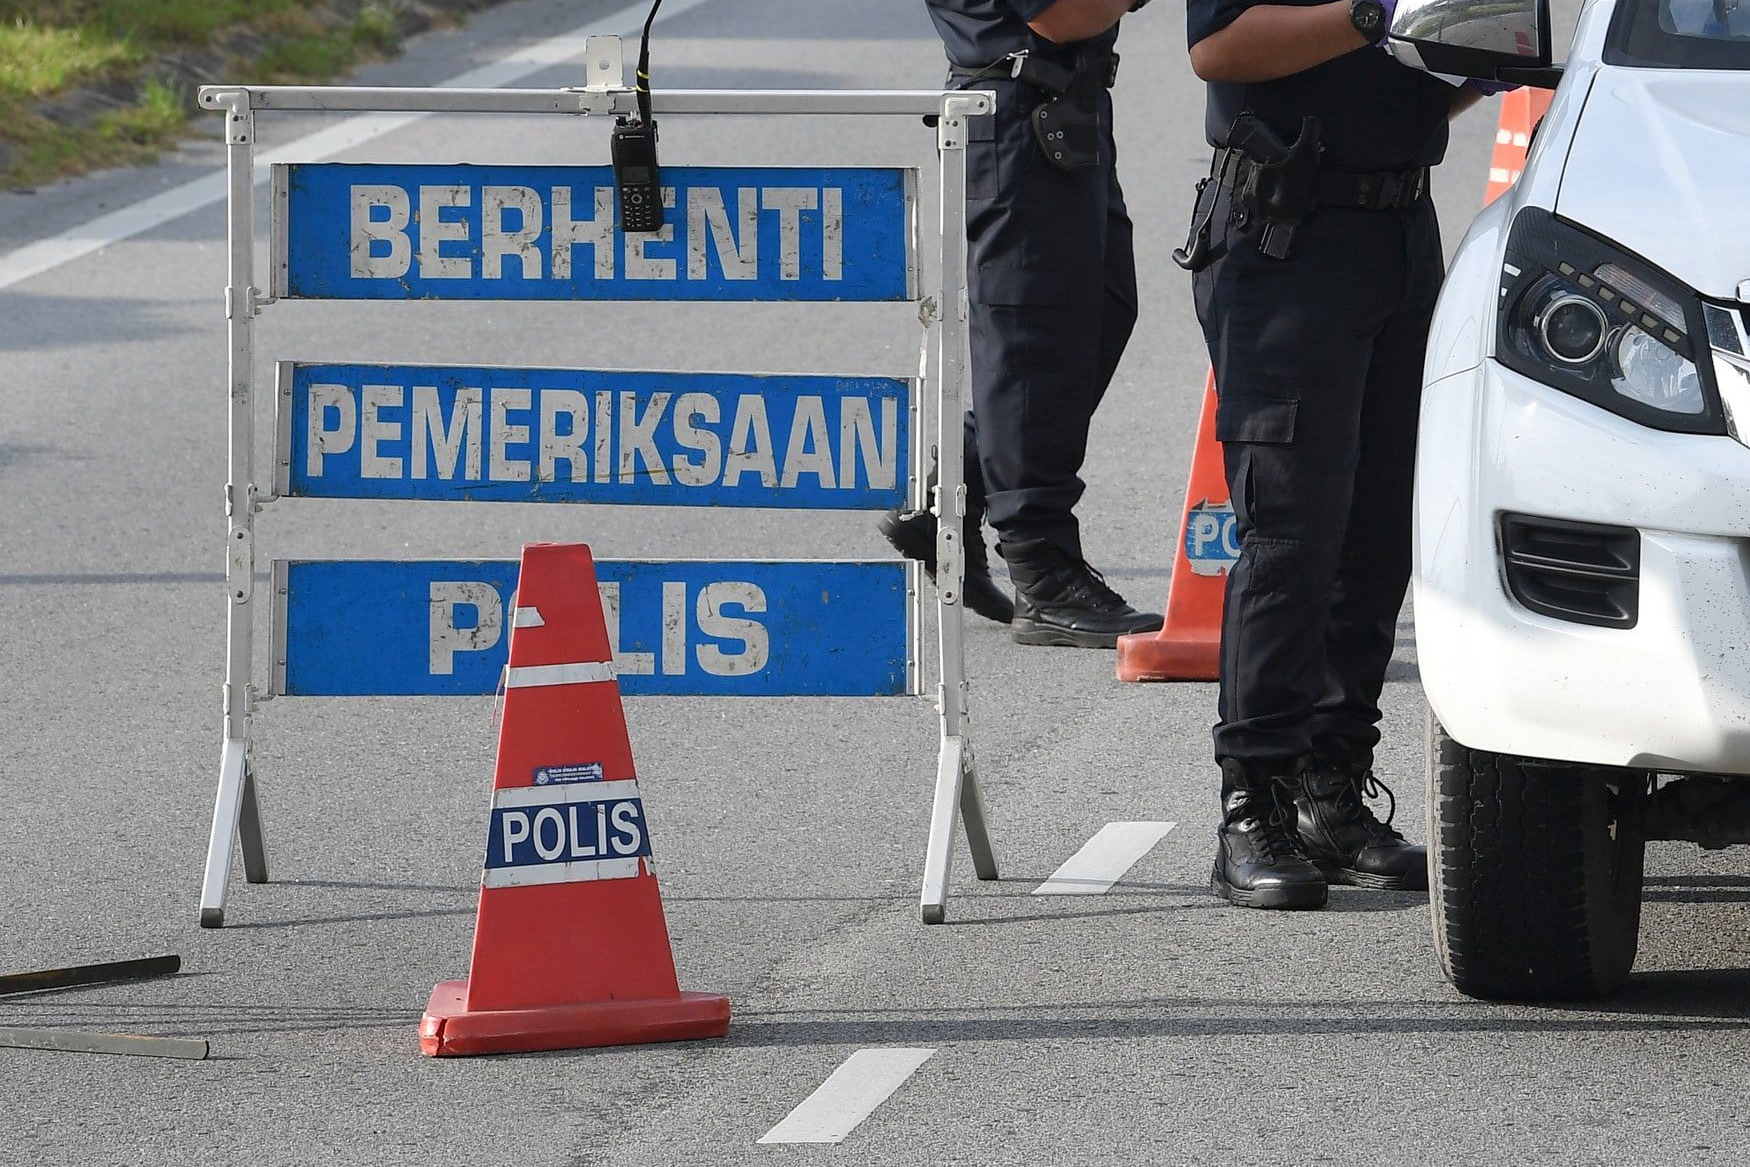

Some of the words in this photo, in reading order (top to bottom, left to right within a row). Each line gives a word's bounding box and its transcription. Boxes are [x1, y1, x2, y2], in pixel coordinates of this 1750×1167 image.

[350, 184, 843, 282] BERHENTI
[307, 384, 898, 490] PEMERIKSAAN
[429, 580, 770, 677] PLIS
[502, 800, 642, 864] POLIS
